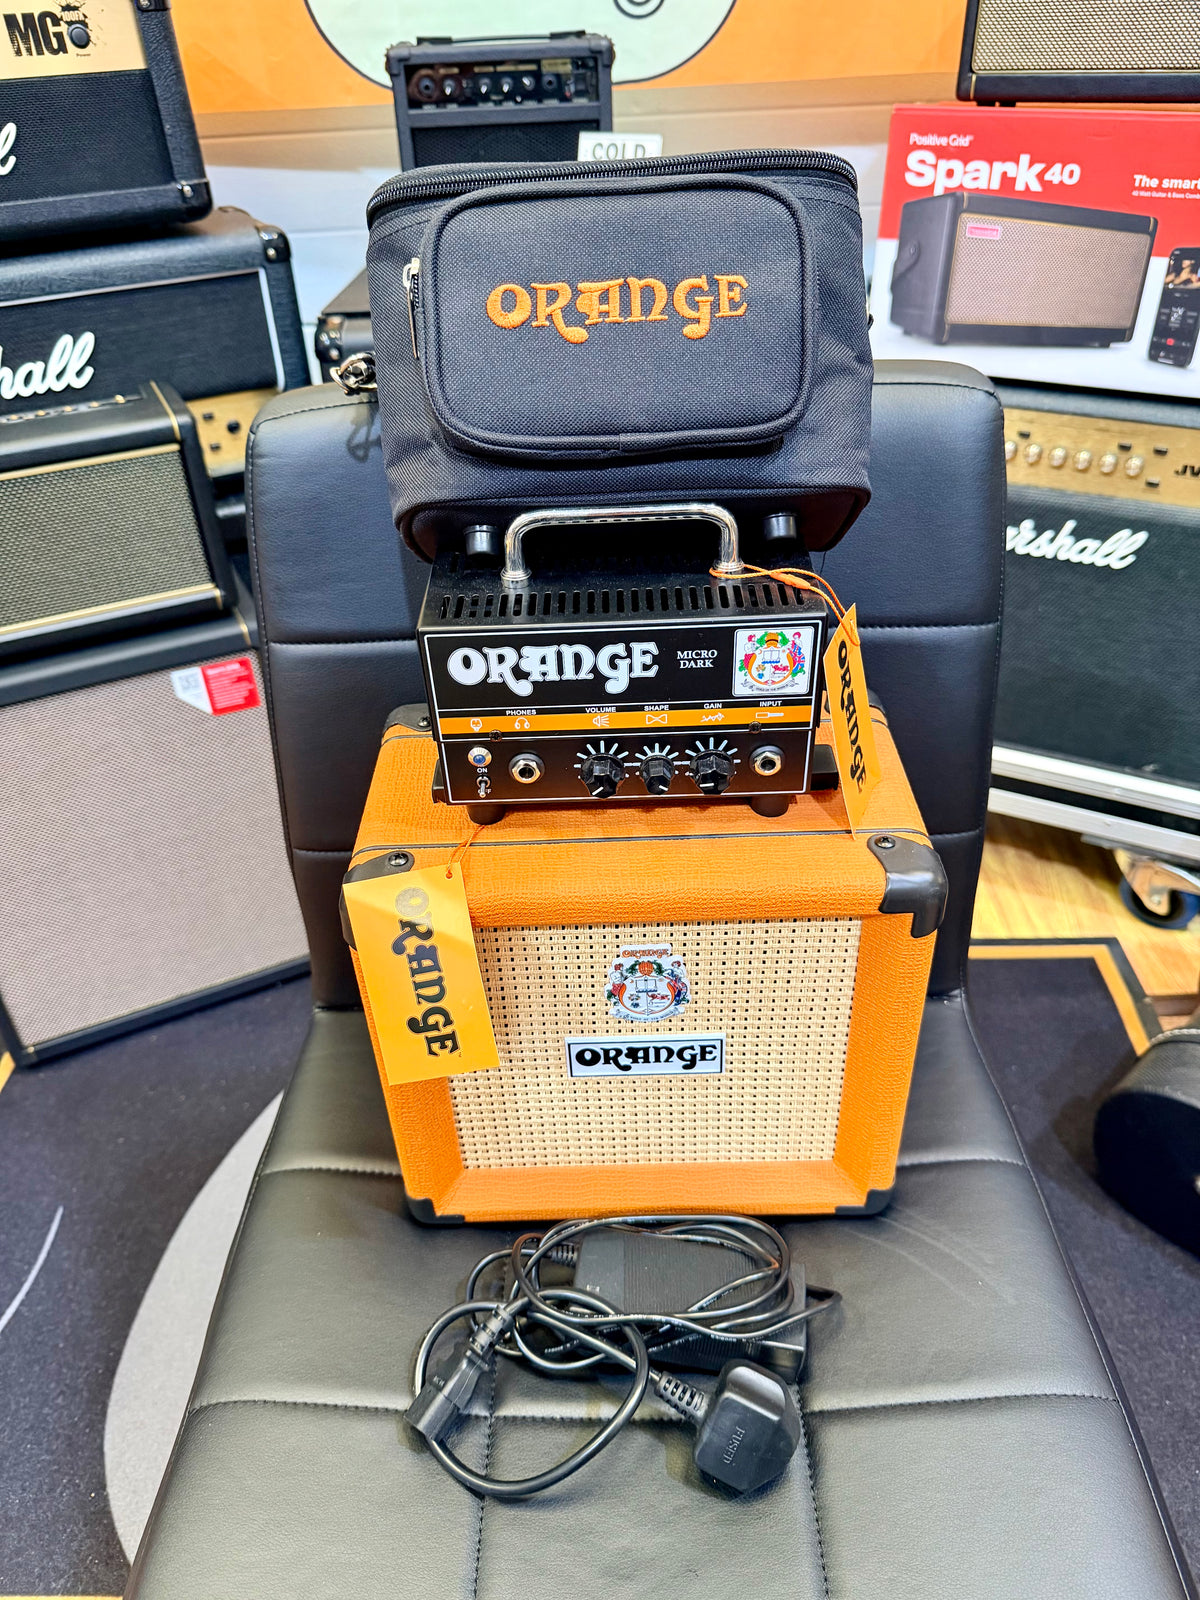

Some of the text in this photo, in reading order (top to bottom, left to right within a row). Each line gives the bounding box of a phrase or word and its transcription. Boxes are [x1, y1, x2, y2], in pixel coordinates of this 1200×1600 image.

[3, 11, 68, 56] MG
[910, 133, 948, 146] Positive
[905, 150, 1081, 196] Spark 40
[1133, 174, 1159, 188] The
[486, 274, 749, 344] ORANGE
[447, 641, 660, 697] ORANGE
[677, 650, 718, 660] MICRO
[679, 659, 714, 669] DARK
[585, 706, 617, 714] VOLUME
[838, 640, 867, 793] ORANGE
[621, 949, 669, 959] ORANGE
[391, 887, 461, 1057] ORANGE
[575, 1044, 718, 1072] ORANGE
[722, 1426, 746, 1464] FUSED
